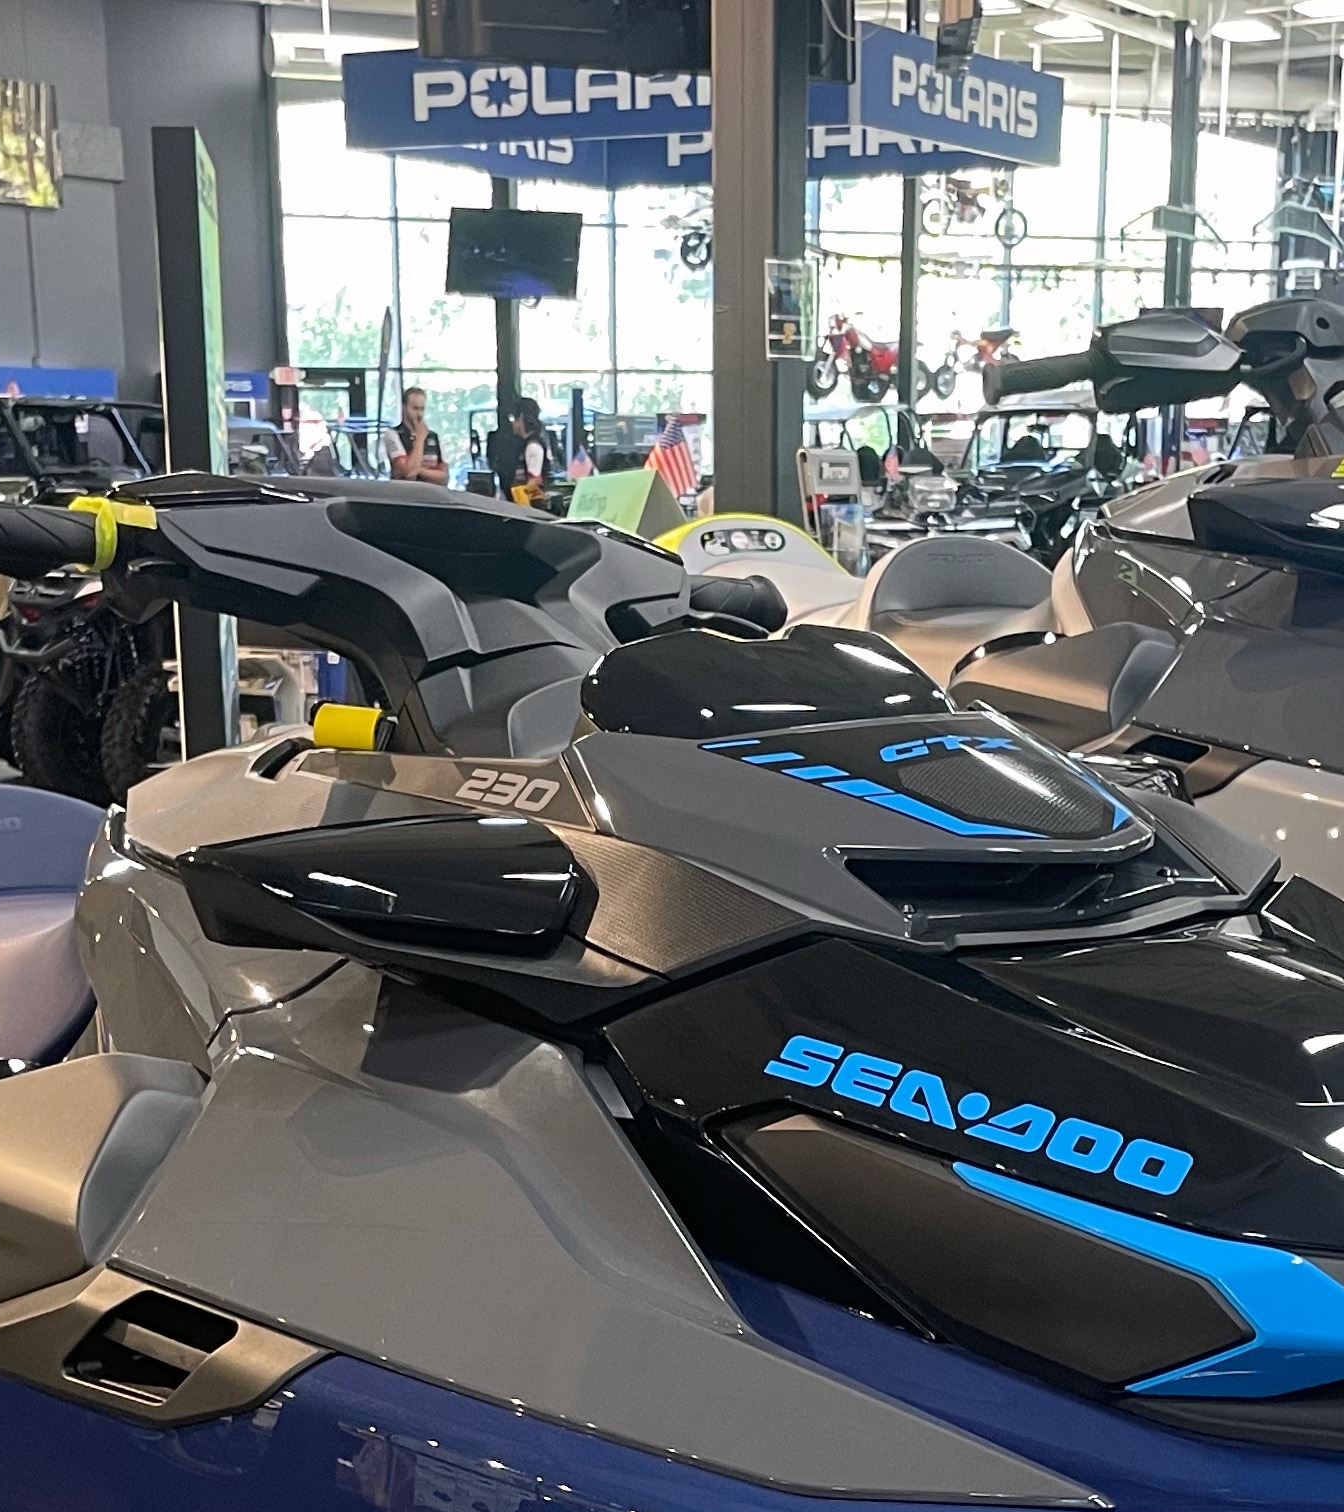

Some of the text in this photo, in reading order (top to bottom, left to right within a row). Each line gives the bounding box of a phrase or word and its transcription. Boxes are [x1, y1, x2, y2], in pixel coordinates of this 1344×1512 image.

[413, 64, 711, 123] POLARI
[892, 55, 1038, 139] POLARIS
[879, 734, 1023, 763] GTX
[455, 768, 561, 812] 230
